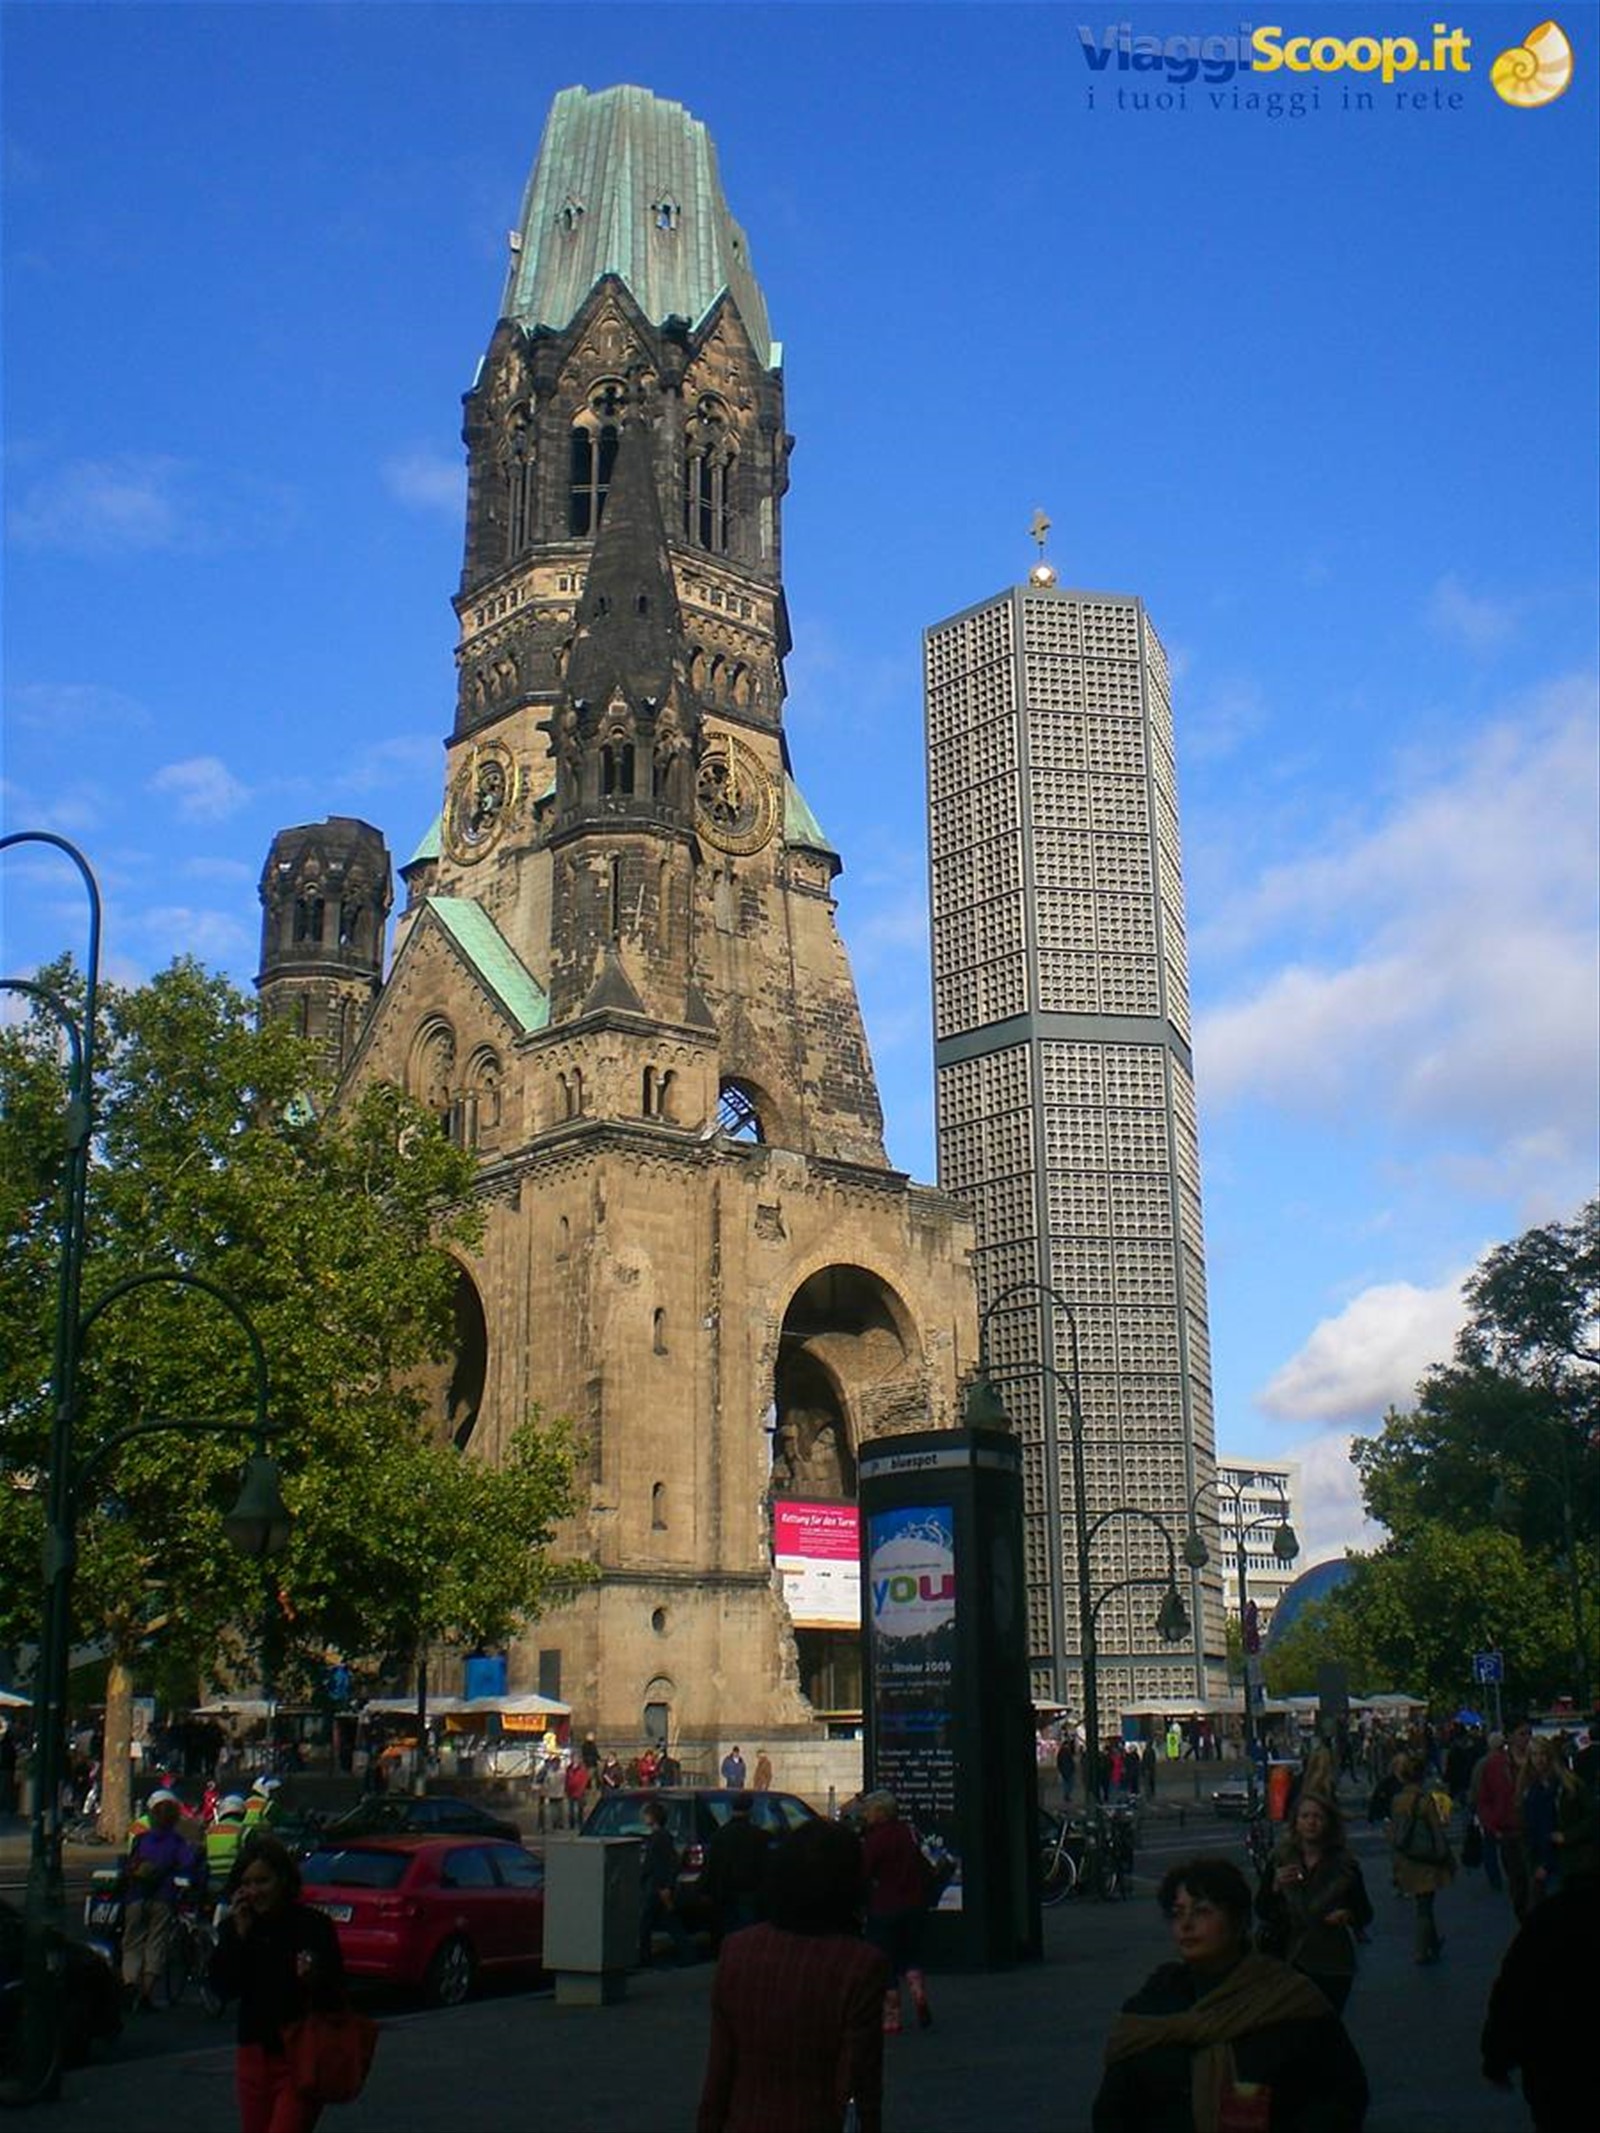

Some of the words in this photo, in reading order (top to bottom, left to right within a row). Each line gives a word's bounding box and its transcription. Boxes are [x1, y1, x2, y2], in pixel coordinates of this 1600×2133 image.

[891, 1453, 938, 1471] bluespot
[872, 1574, 955, 1616] you
[924, 1660, 952, 1673] 2009
